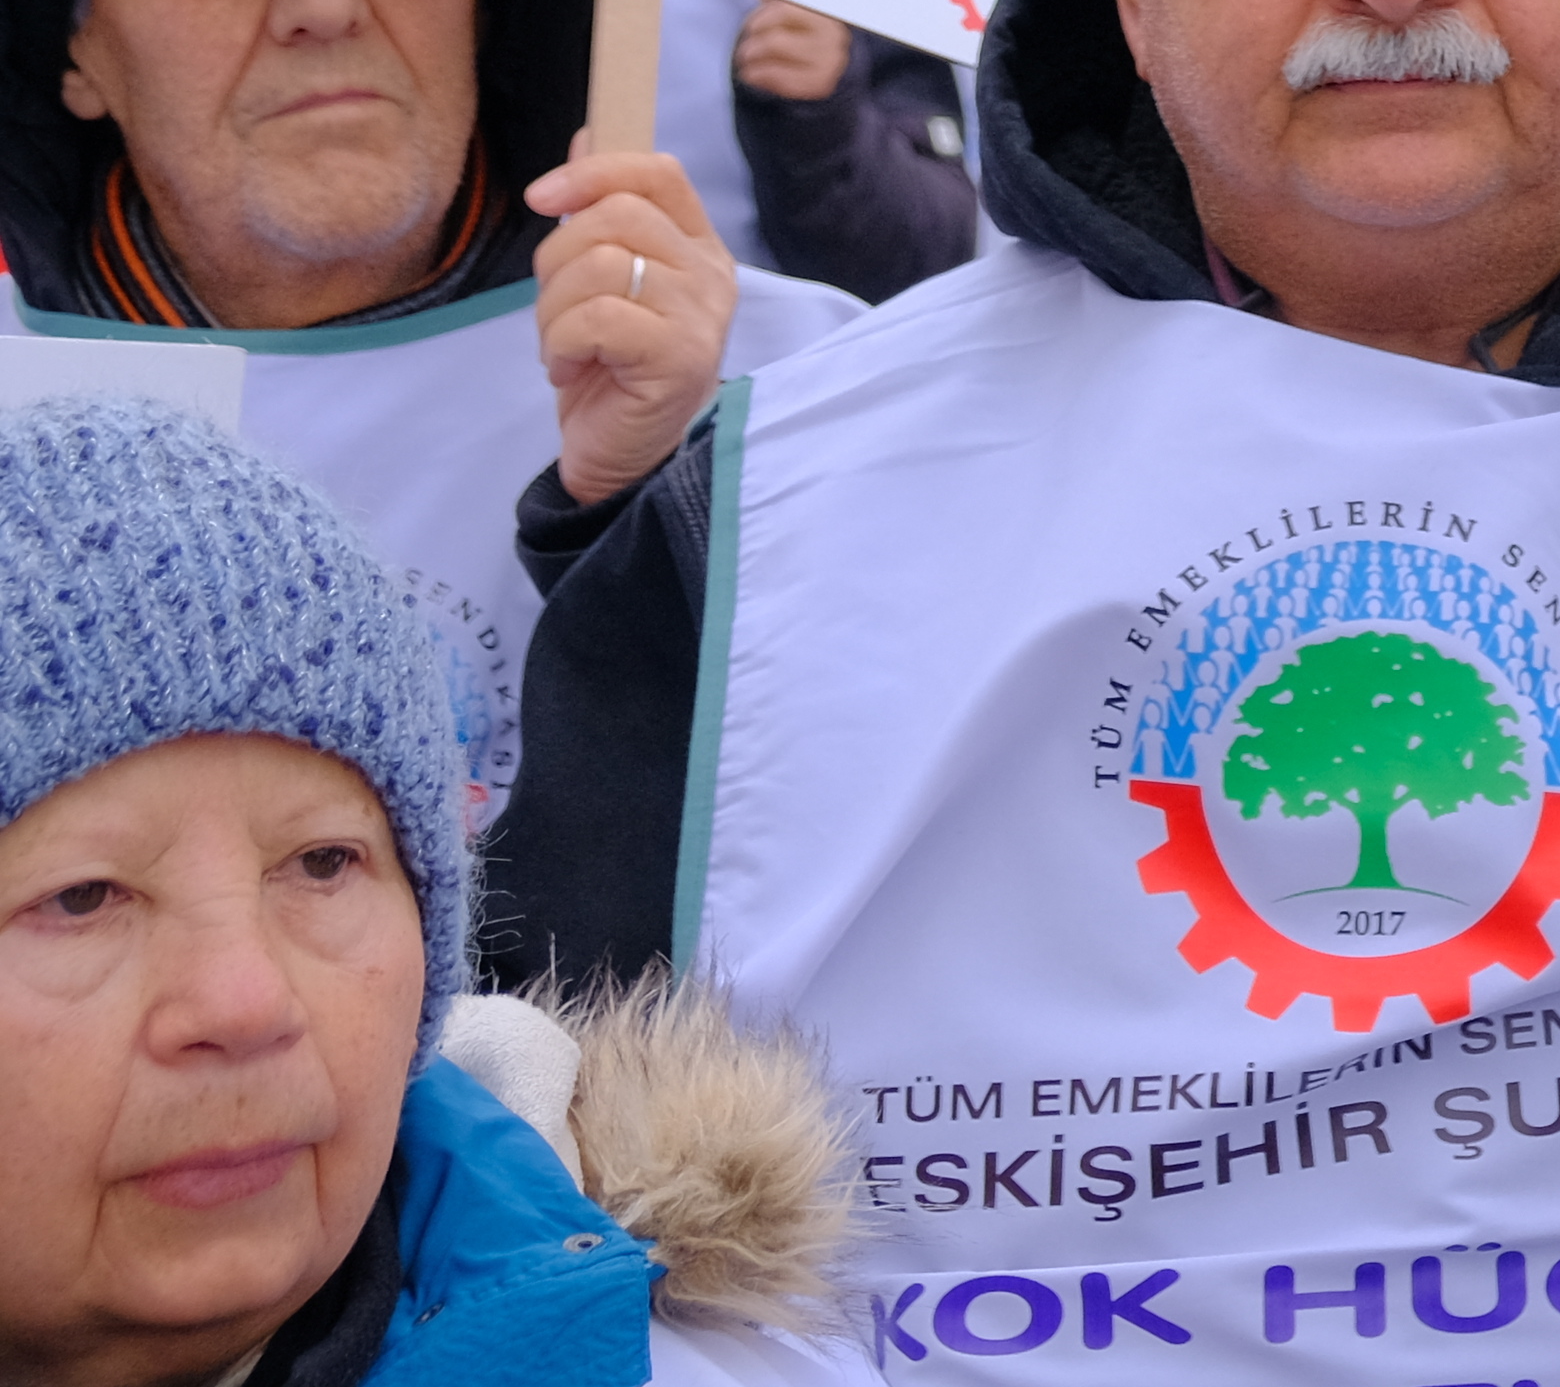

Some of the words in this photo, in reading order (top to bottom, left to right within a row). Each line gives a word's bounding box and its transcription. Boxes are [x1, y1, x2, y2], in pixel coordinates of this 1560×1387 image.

[1092, 676, 1130, 789] TÜM
[1126, 499, 1480, 654] EMEKLİLERİN
[1334, 910, 1407, 938] 2017
[862, 1076, 1004, 1124] TÜM
[1031, 1031, 1433, 1117] EMEKLİLERİN
[860, 1100, 1393, 1223] ESKİŞEHİR
